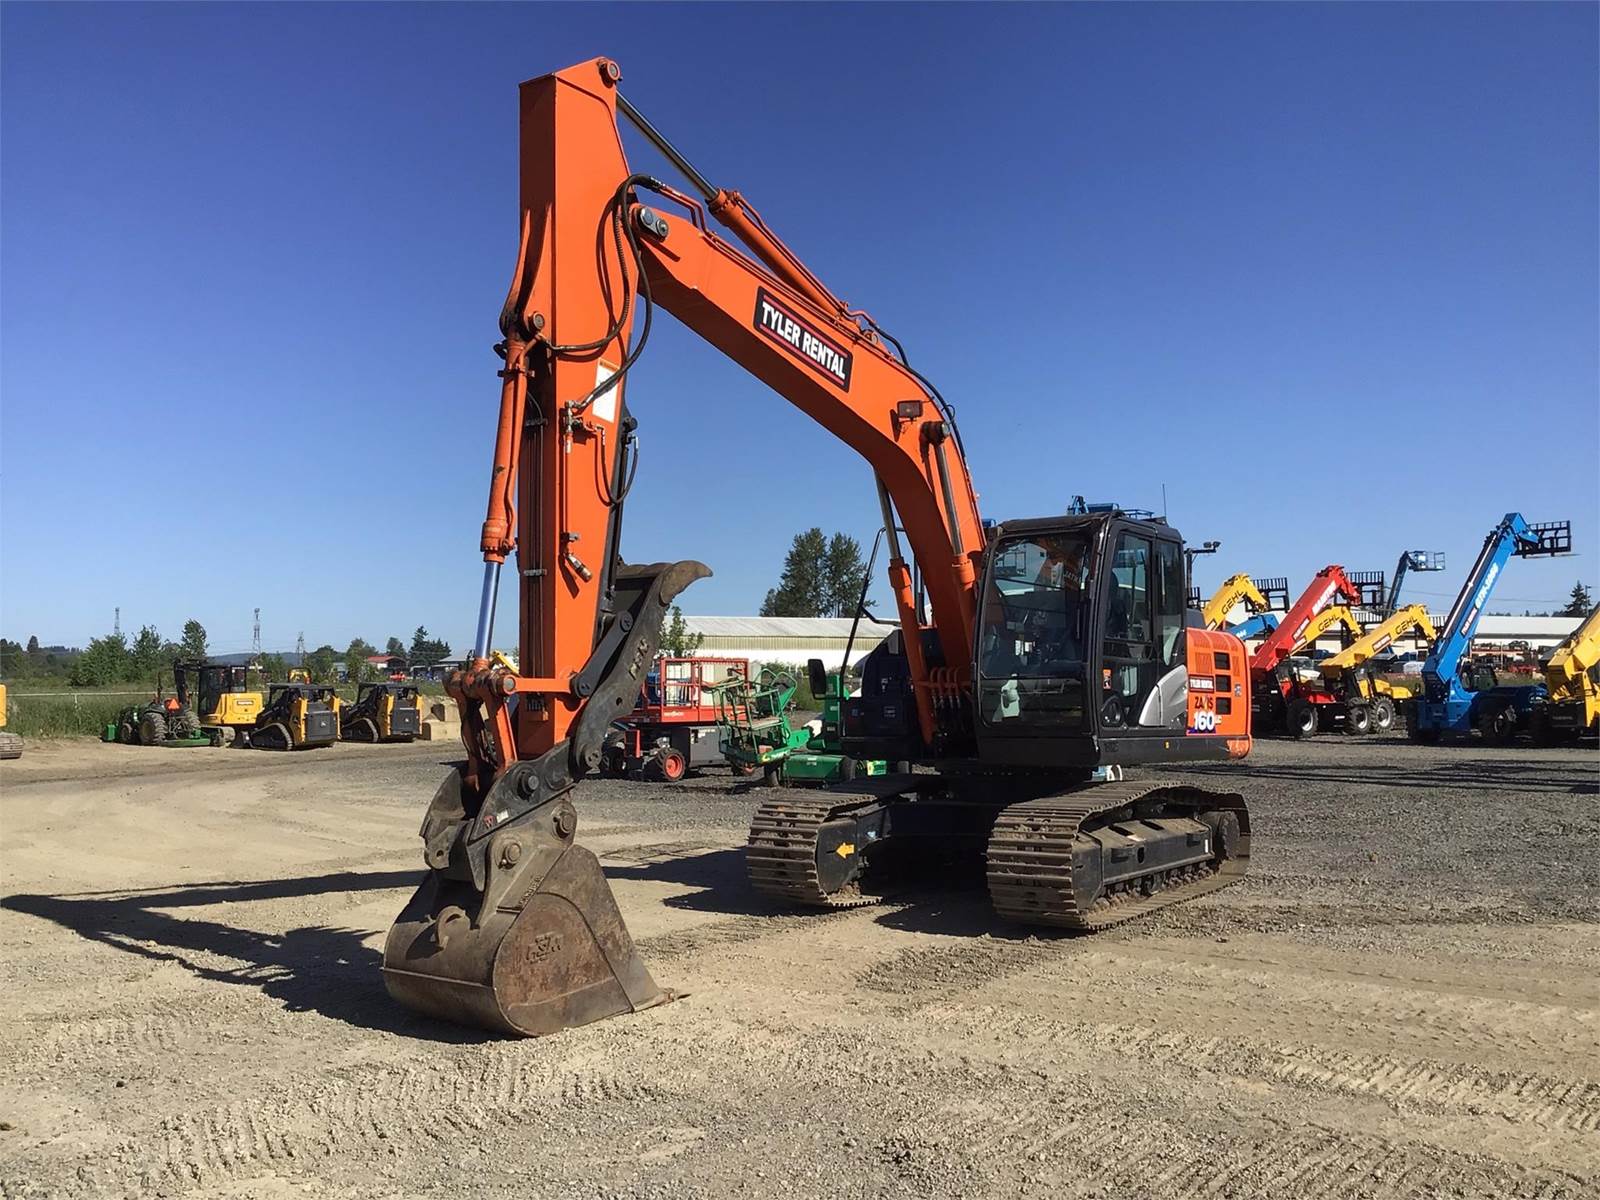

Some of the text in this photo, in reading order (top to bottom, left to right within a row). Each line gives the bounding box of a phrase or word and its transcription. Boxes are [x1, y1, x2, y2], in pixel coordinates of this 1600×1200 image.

[761, 301, 846, 380] TYLER RENTAL
[1221, 590, 1244, 615] GEHL
[1318, 614, 1341, 632] GEHL
[1395, 616, 1418, 635] GEHL
[1193, 710, 1215, 730] 160
